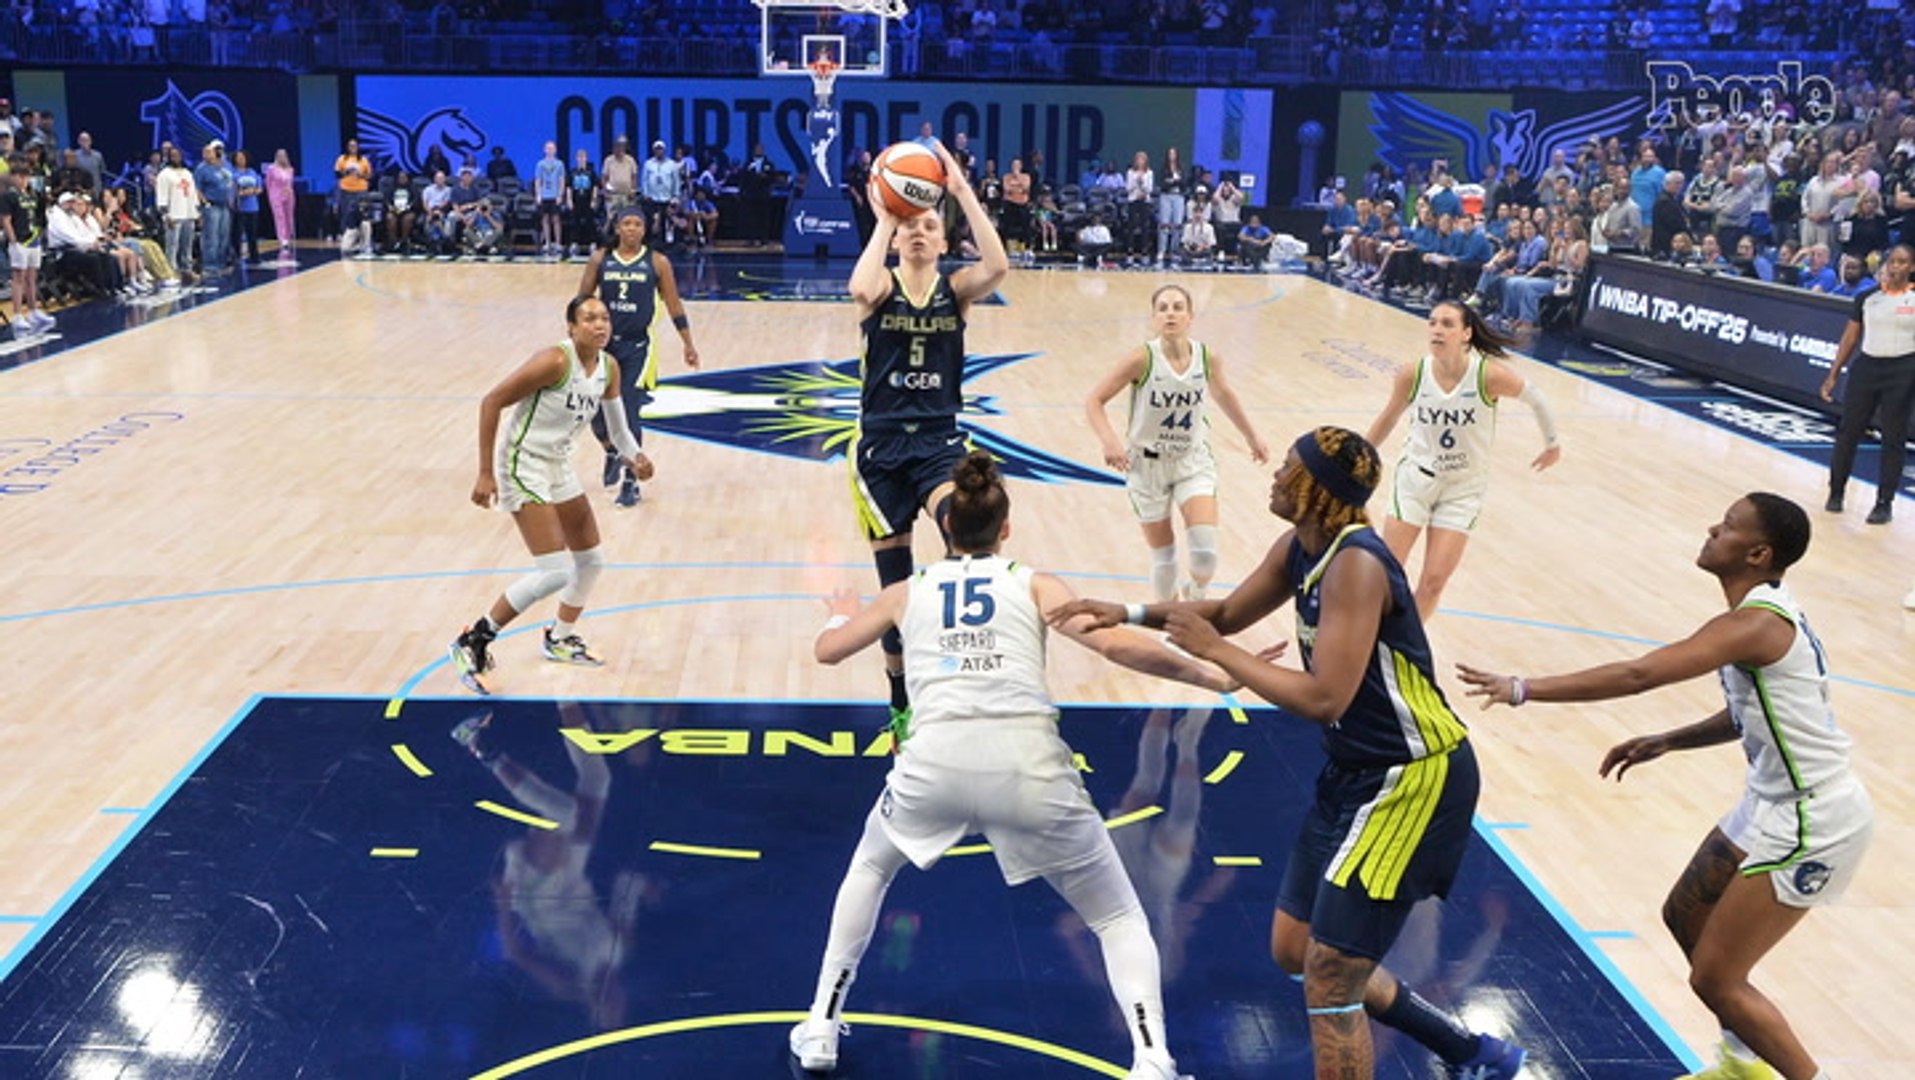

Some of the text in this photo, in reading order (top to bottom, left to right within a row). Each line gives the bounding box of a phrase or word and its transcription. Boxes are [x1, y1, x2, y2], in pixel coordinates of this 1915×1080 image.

[619, 281, 629, 300] 2
[1599, 284, 1649, 319] WNBA
[880, 312, 957, 333] DALLAS
[909, 335, 926, 367] 5
[566, 391, 601, 411] LYN
[1149, 388, 1204, 408] LYNX
[1160, 410, 1193, 431] 44
[1417, 406, 1476, 427] LYNX
[1438, 427, 1457, 450] 6
[937, 576, 997, 629] 15
[960, 653, 1004, 672] AT&T
